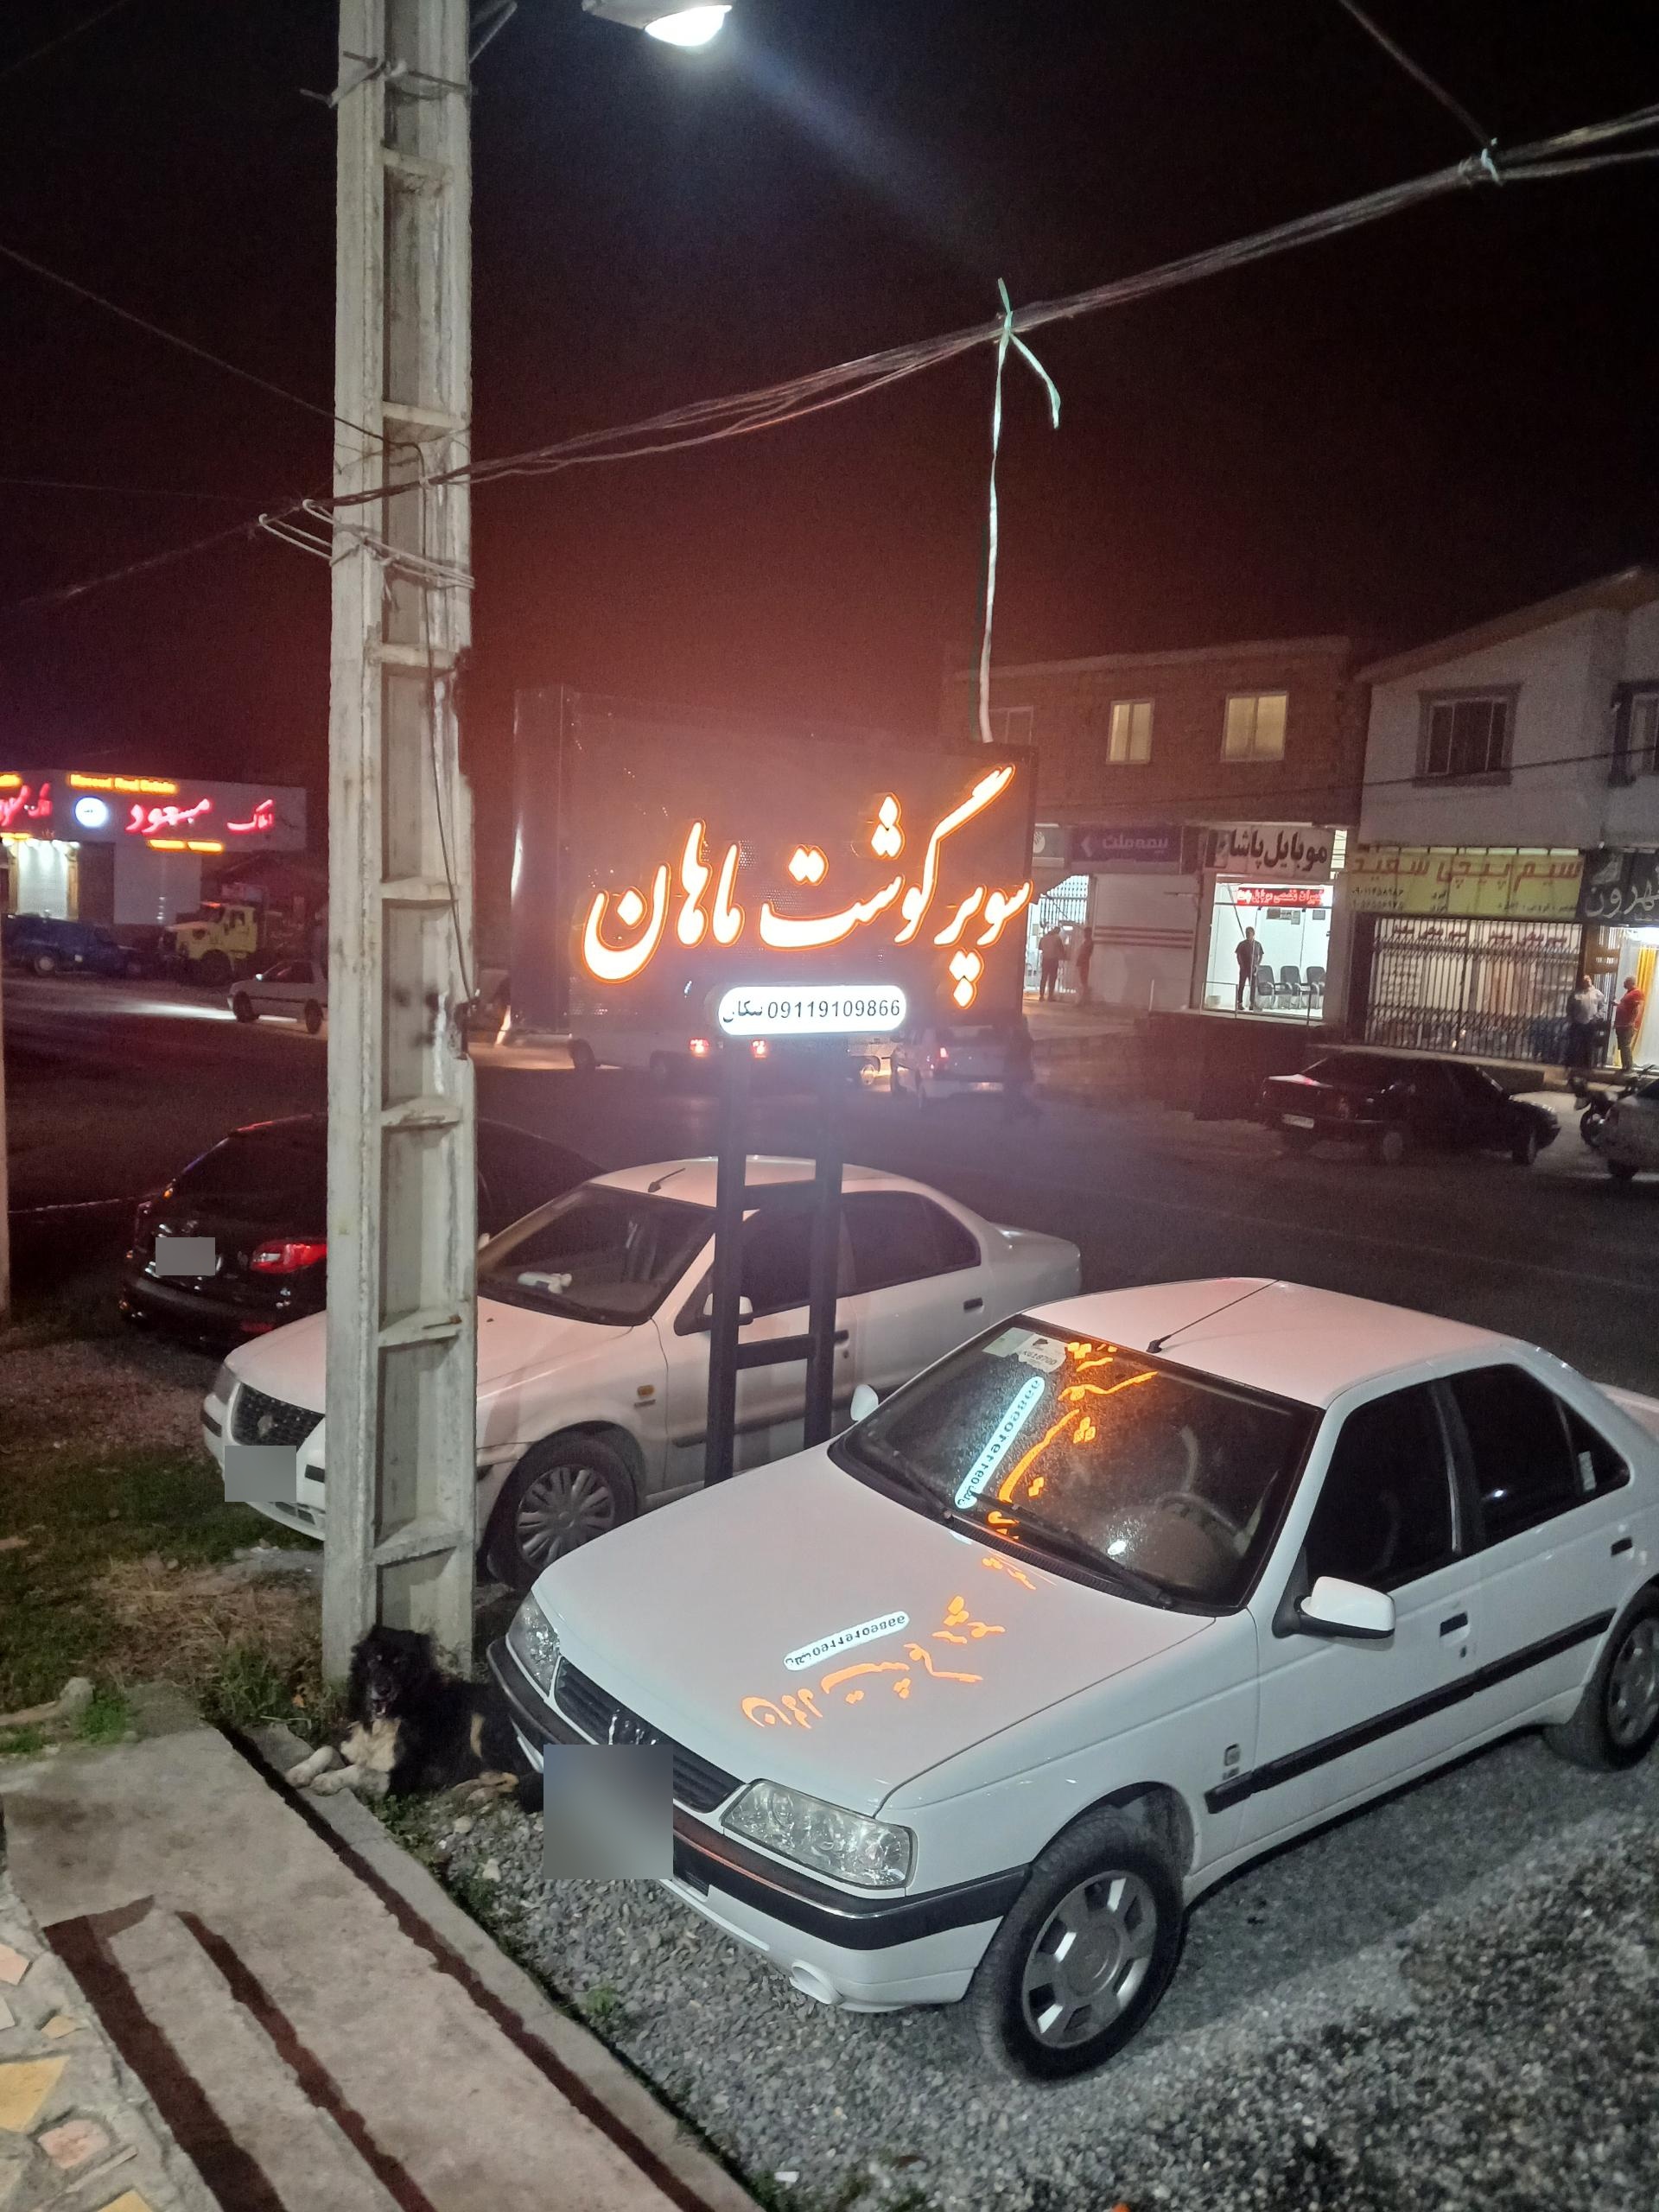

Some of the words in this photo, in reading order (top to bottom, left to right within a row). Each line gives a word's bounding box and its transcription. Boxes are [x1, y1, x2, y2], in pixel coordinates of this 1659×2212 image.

[760, 764, 1016, 949] گوشت
[1230, 828, 1264, 869] پاشا
[1263, 830, 1328, 872] موبایل
[1351, 858, 1429, 881] سعید
[1436, 858, 1511, 889] پیچی
[1513, 860, 1581, 893] سیم
[583, 818, 746, 984] ماهان
[934, 879, 1033, 1009] سوپر
[767, 1000, 899, 1019] 09119109866
